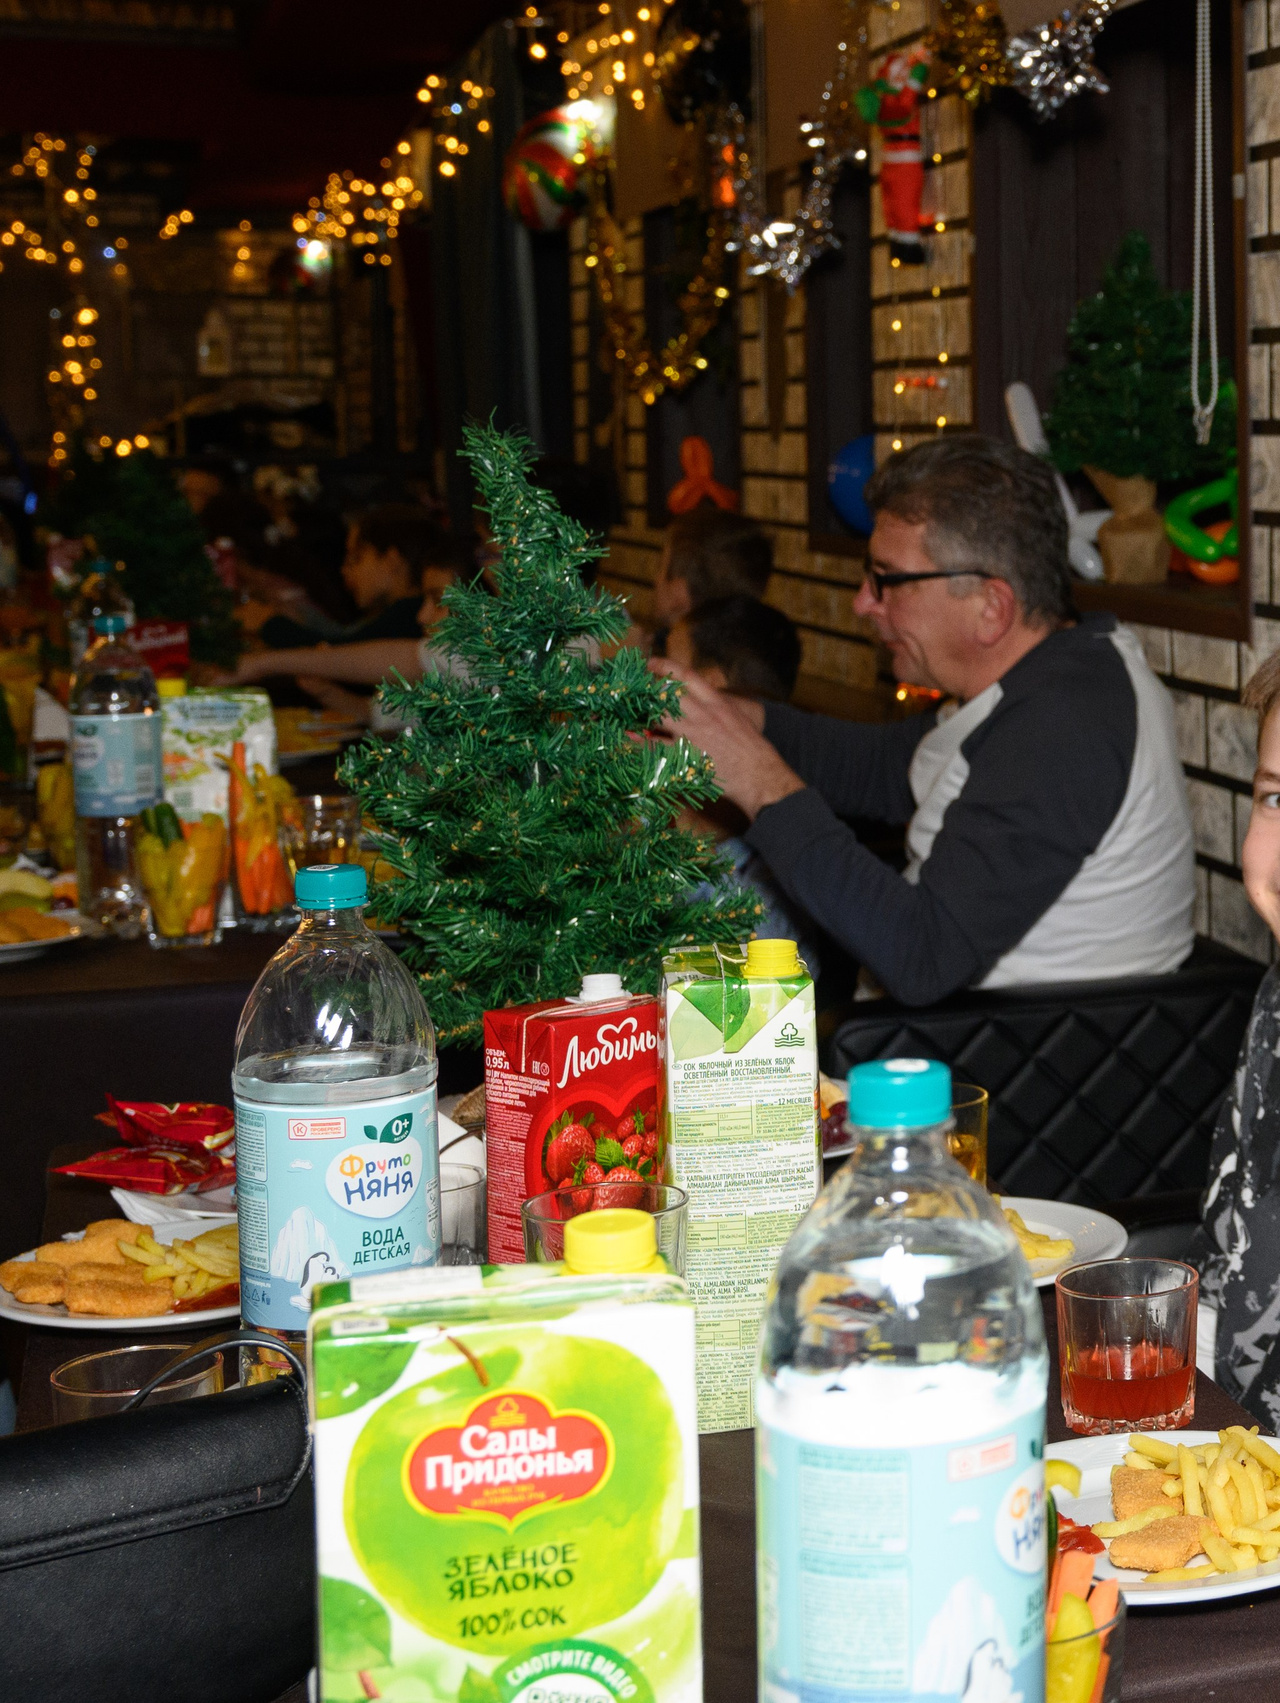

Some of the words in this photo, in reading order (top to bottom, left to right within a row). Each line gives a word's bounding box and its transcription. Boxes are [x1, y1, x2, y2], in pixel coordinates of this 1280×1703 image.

[683, 1062, 696, 1072] СОК
[698, 1059, 733, 1070] ЯБЛОЧНЫЙ
[734, 1058, 743, 1068] ИЗ
[744, 1057, 773, 1068] ЗЕЛЁНЫХ
[774, 1056, 796, 1066] ЯБЛОК
[683, 1069, 728, 1080] ОСВЕТЛЁННЫЙ
[730, 1066, 792, 1077] ВОССТАНОВЛЕННЫЙ.
[778, 1098, 786, 1106] 12
[391, 1118, 410, 1136] 0+
[339, 1154, 412, 1179] Фруто
[765, 1177, 779, 1185] АЛМА
[794, 1203, 801, 1211] 12
[362, 1226, 405, 1247] ВОДА
[353, 1242, 411, 1266] ДЕТСКАЯ
[704, 1280, 735, 1288] ALMALARDAN
[718, 1286, 731, 1294] ALMA
[459, 1424, 557, 1459] Сады
[424, 1448, 595, 1495] Придонья
[444, 1543, 578, 1579] ЗЕЛЁНОЕ
[448, 1568, 574, 1601] ЯБЛОКО
[458, 1607, 517, 1638] 100%
[520, 1605, 567, 1630] СОК
[505, 1649, 594, 1687] СМОТРИТЕ
[590, 1654, 638, 1700] ВИДЕО
